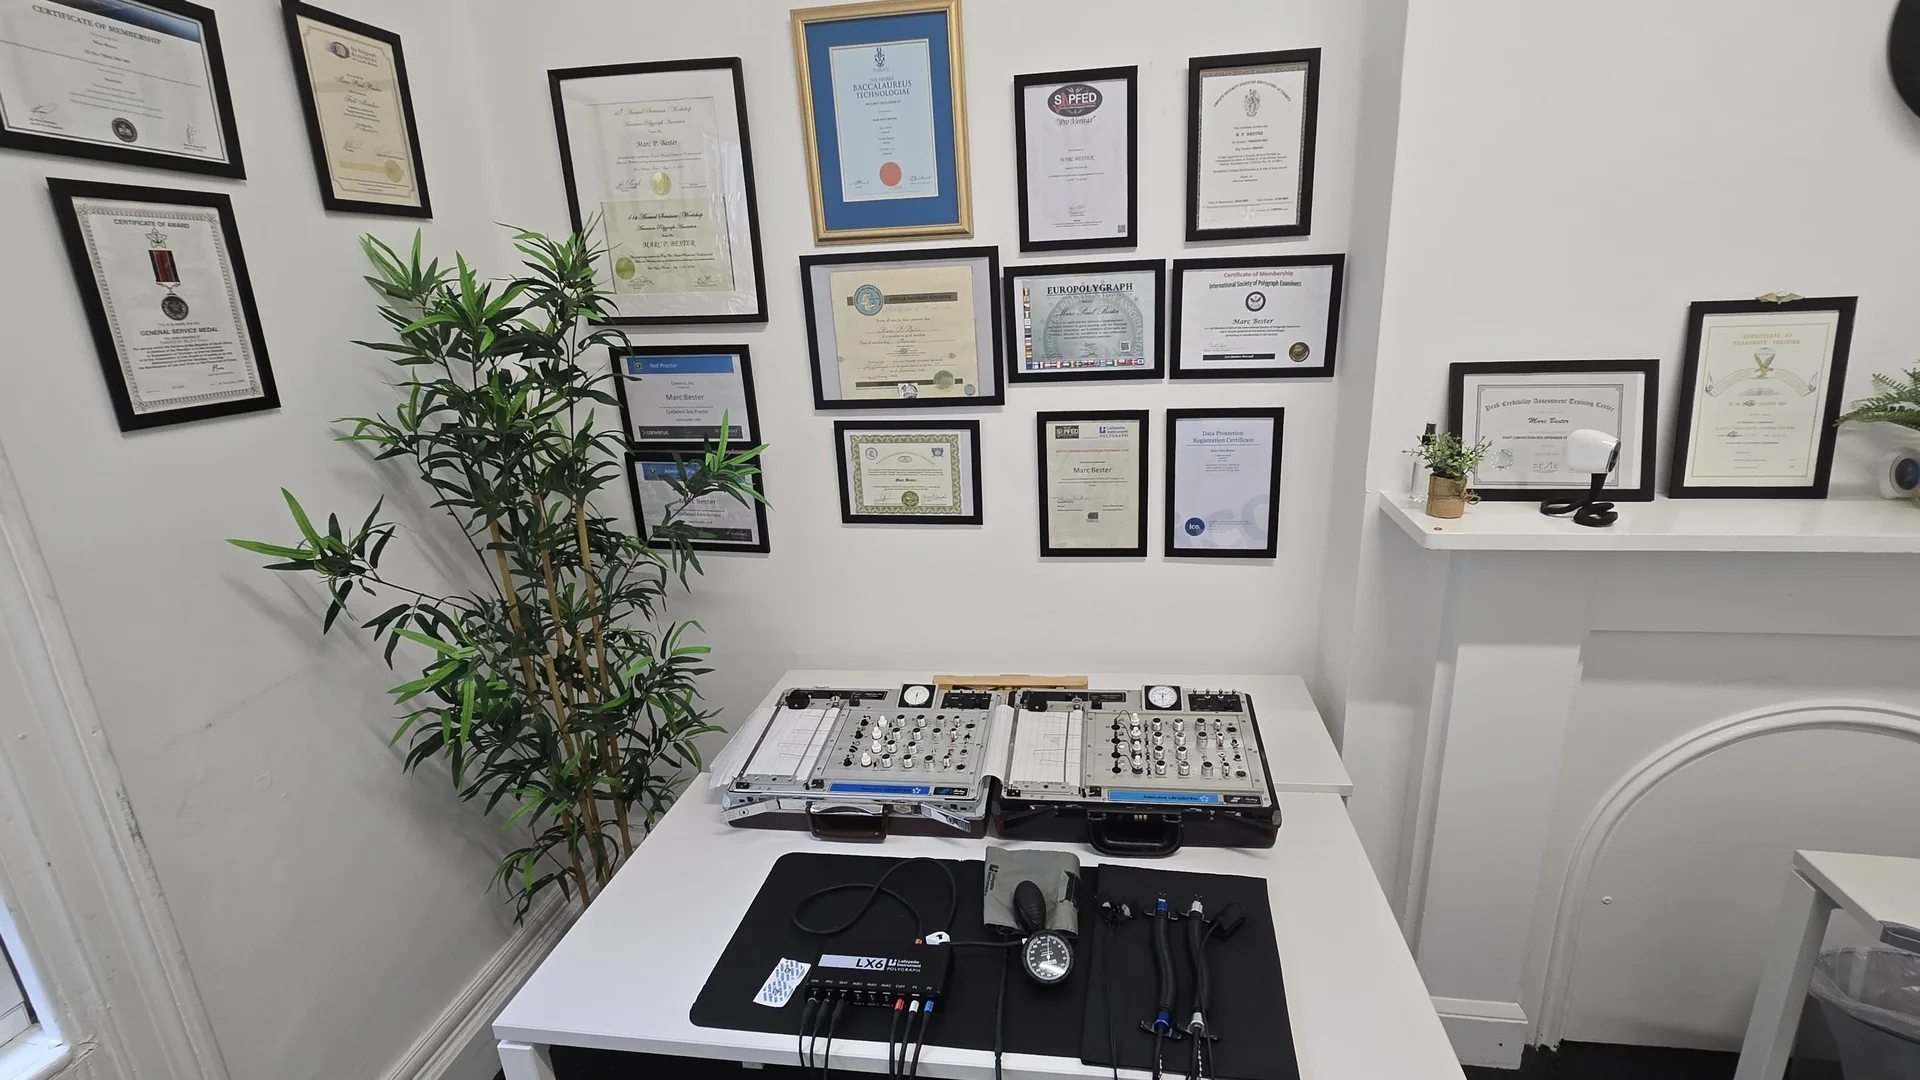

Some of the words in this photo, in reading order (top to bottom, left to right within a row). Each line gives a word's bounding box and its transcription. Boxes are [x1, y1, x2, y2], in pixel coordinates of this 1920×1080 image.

[32, 4, 94, 27] CERTIFICATE
[95, 22, 106, 30] OF
[108, 25, 162, 45] MEMBERSHIP
[853, 80, 912, 92] BACCALAUREUS
[856, 88, 911, 99] TECHNOLOGIAE
[113, 219, 156, 227] CERTIFICATE
[1047, 282, 1133, 295] EUROPOLYGRAPH
[1209, 281, 1236, 289] International
[1485, 402, 1500, 412] Peak
[1502, 399, 1531, 407] Credibility
[1568, 398, 1594, 407] Training
[1596, 402, 1615, 412] Center
[856, 958, 884, 969] LX6
